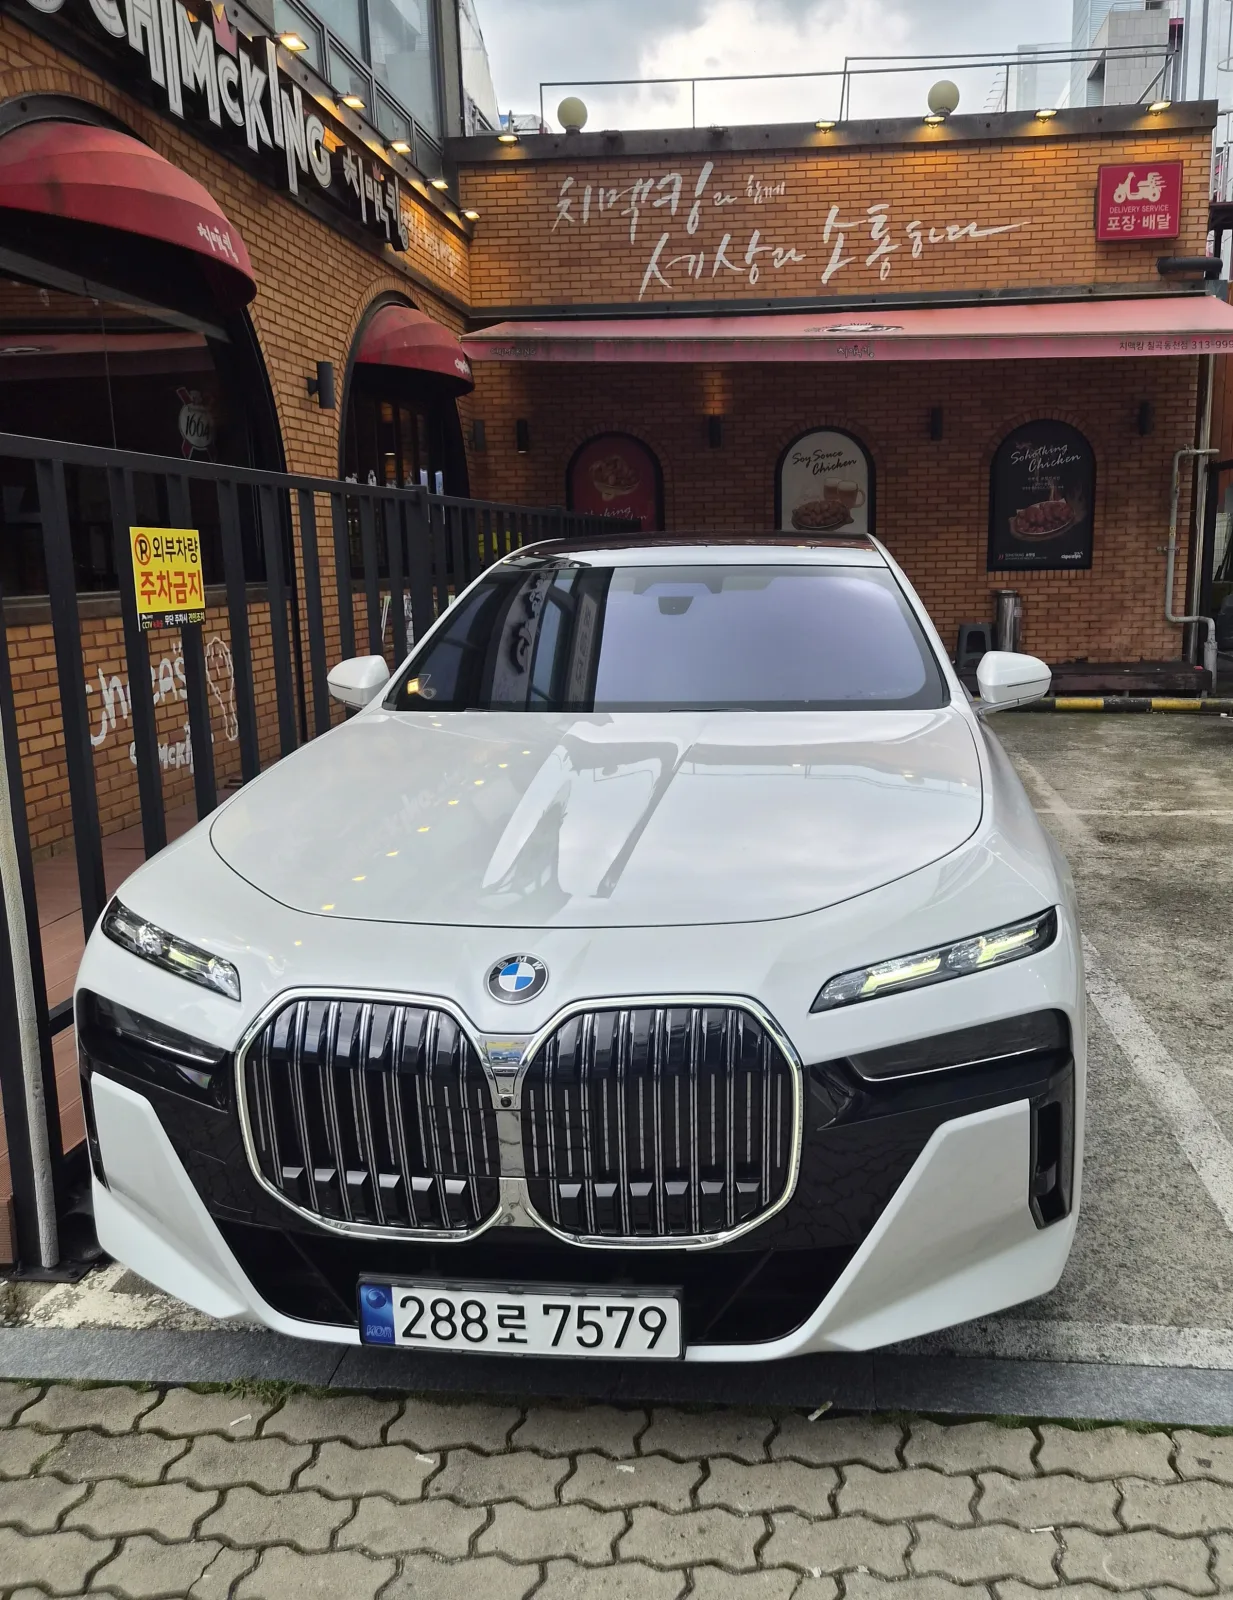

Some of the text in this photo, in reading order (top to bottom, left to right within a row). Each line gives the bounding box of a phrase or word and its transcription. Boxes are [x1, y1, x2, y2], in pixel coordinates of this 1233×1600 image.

[342, 147, 410, 252] 치맥킹
[745, 174, 786, 205] 함께
[1109, 204, 1169, 214] DELIVERY SERVICE
[196, 222, 240, 264] 치맥킹
[638, 229, 807, 301] 세상과
[1119, 340, 1145, 351] 치맥킹
[1146, 339, 1188, 351] 칠곡동천점
[185, 413, 211, 441] 1664
[792, 451, 813, 469] Soy
[812, 457, 857, 476] Chicken
[1028, 452, 1082, 473] Chicken
[152, 535, 199, 564] 외부차량
[140, 569, 203, 605] 주차금지
[142, 621, 152, 629] CCTV
[399, 1294, 668, 1350] 288로 7579
